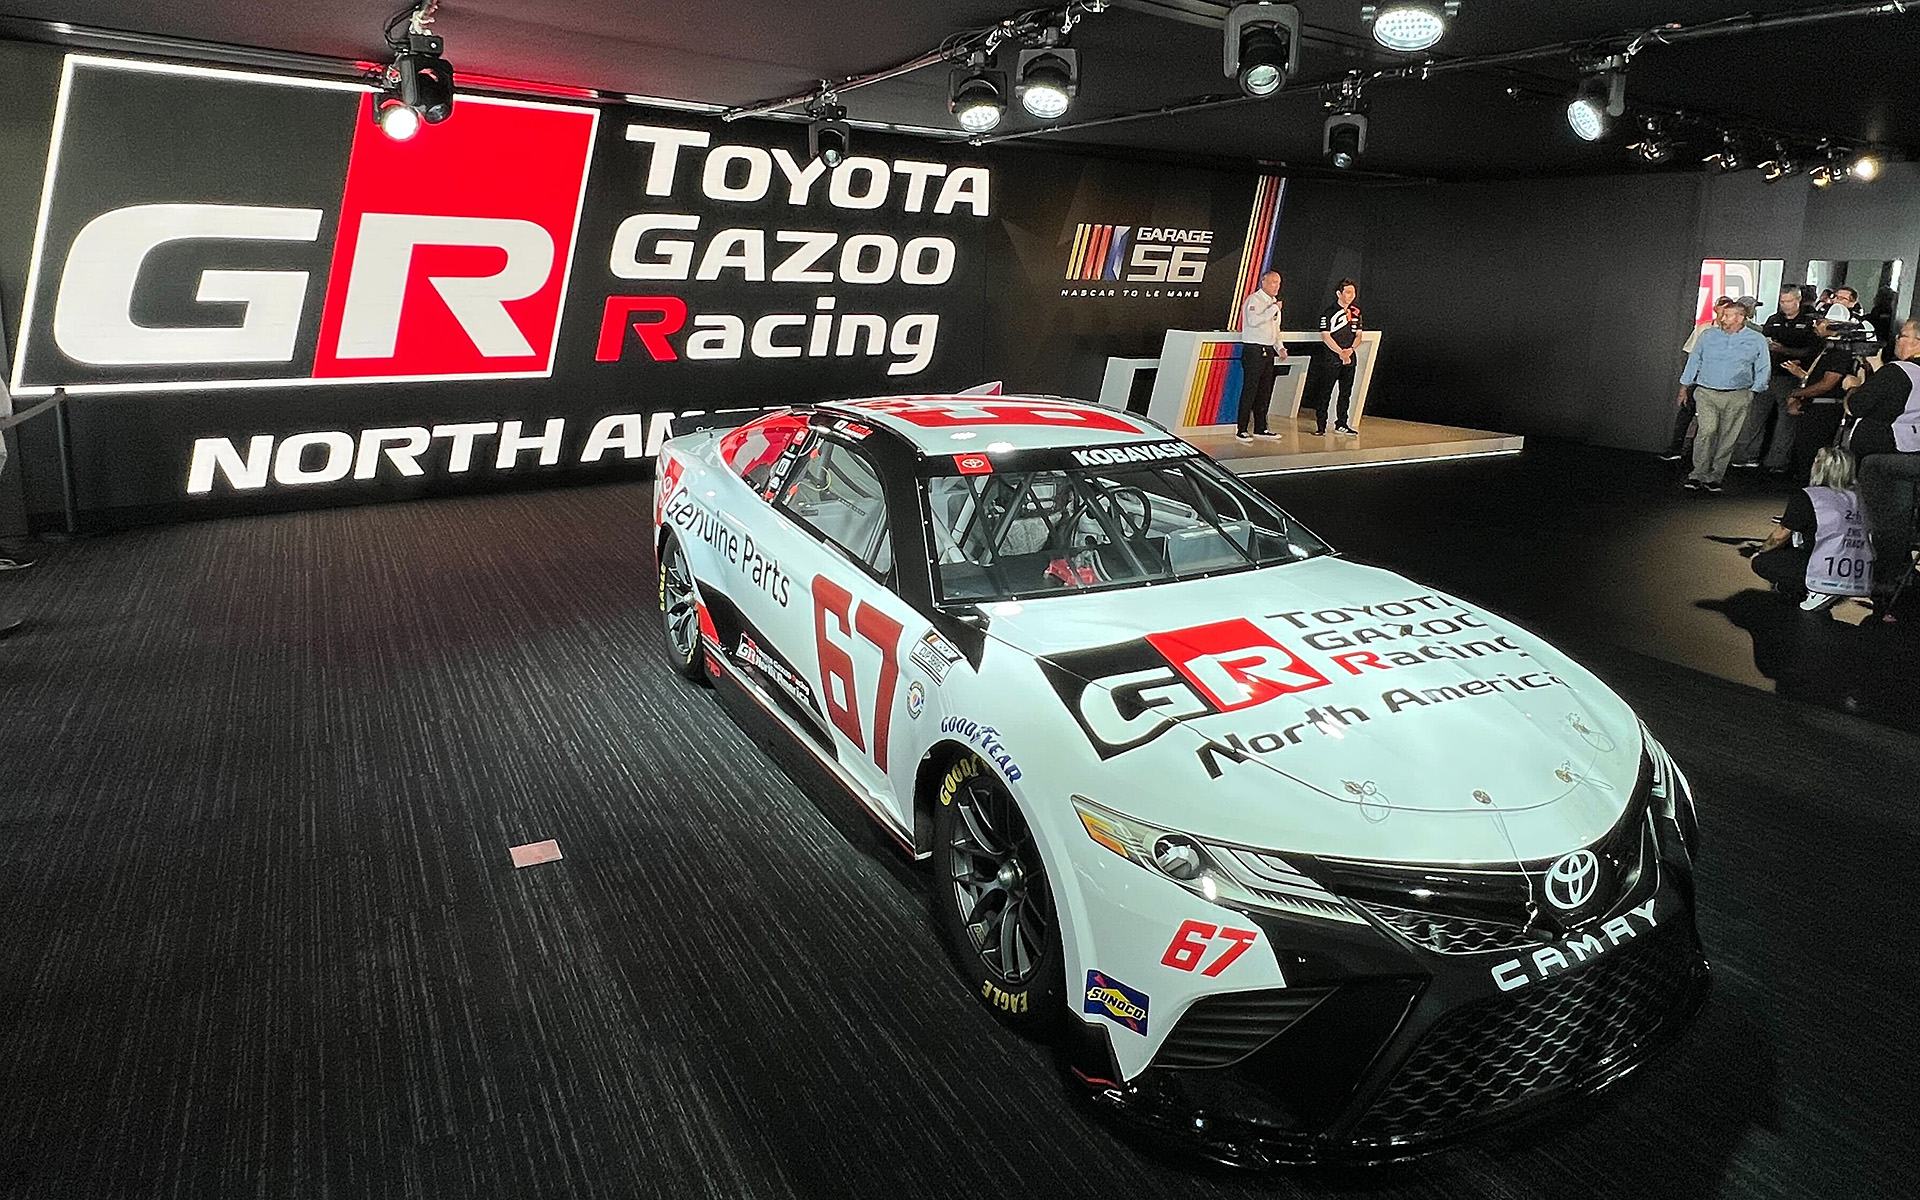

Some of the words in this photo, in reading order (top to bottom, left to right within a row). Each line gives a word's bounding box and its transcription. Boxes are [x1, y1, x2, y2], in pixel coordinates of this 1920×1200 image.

[626, 125, 990, 217] TOYOTA
[609, 213, 957, 285] GAZOO
[1126, 244, 1211, 283] 56
[1137, 227, 1213, 244] GARAGE
[54, 203, 555, 364] GR
[1060, 289, 1115, 298] NASCAR
[1122, 289, 1139, 298] TO
[1146, 290, 1161, 298] LE
[1166, 290, 1200, 298] MANS
[595, 295, 939, 376] Racing
[186, 417, 566, 496] NORTH
[1071, 442, 1199, 466] KOBAYASHI
[666, 486, 738, 564] Genuine
[742, 534, 790, 608] Parts
[812, 574, 904, 775] 67
[1079, 645, 1321, 745] GR
[941, 716, 1022, 784] GOODYEAR
[1196, 705, 1370, 779] North
[1161, 919, 1258, 978] 67
[1491, 899, 1658, 992] CAMRY
[981, 979, 1028, 1014] EAGLE
[1088, 986, 1145, 1020] SUNOCO
